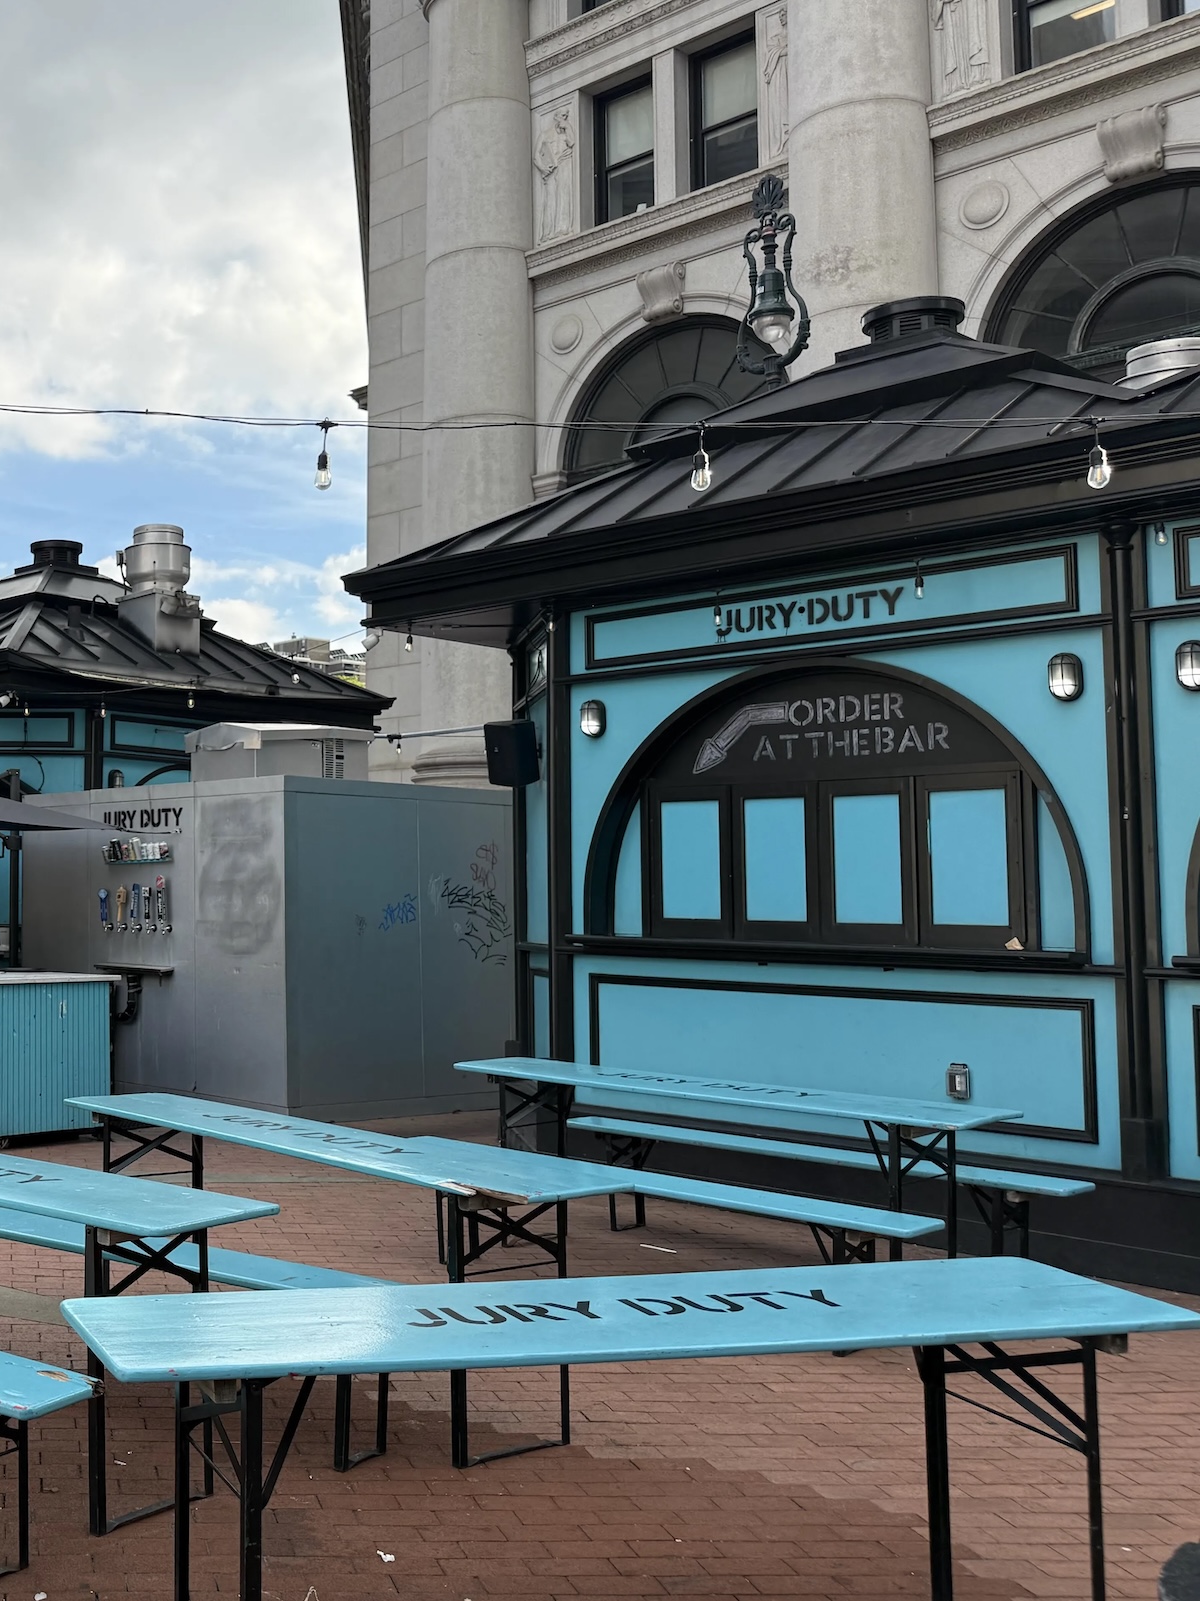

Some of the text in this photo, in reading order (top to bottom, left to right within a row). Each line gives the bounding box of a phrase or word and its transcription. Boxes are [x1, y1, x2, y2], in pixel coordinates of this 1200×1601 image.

[807, 587, 904, 625] DUTY
[788, 693, 904, 726] ORDER
[140, 807, 183, 828] DUTY
[597, 1072, 828, 1098] JURY DUTY
[202, 1114, 425, 1155] JURY DUTY
[406, 1289, 842, 1328] JURY DUTY
